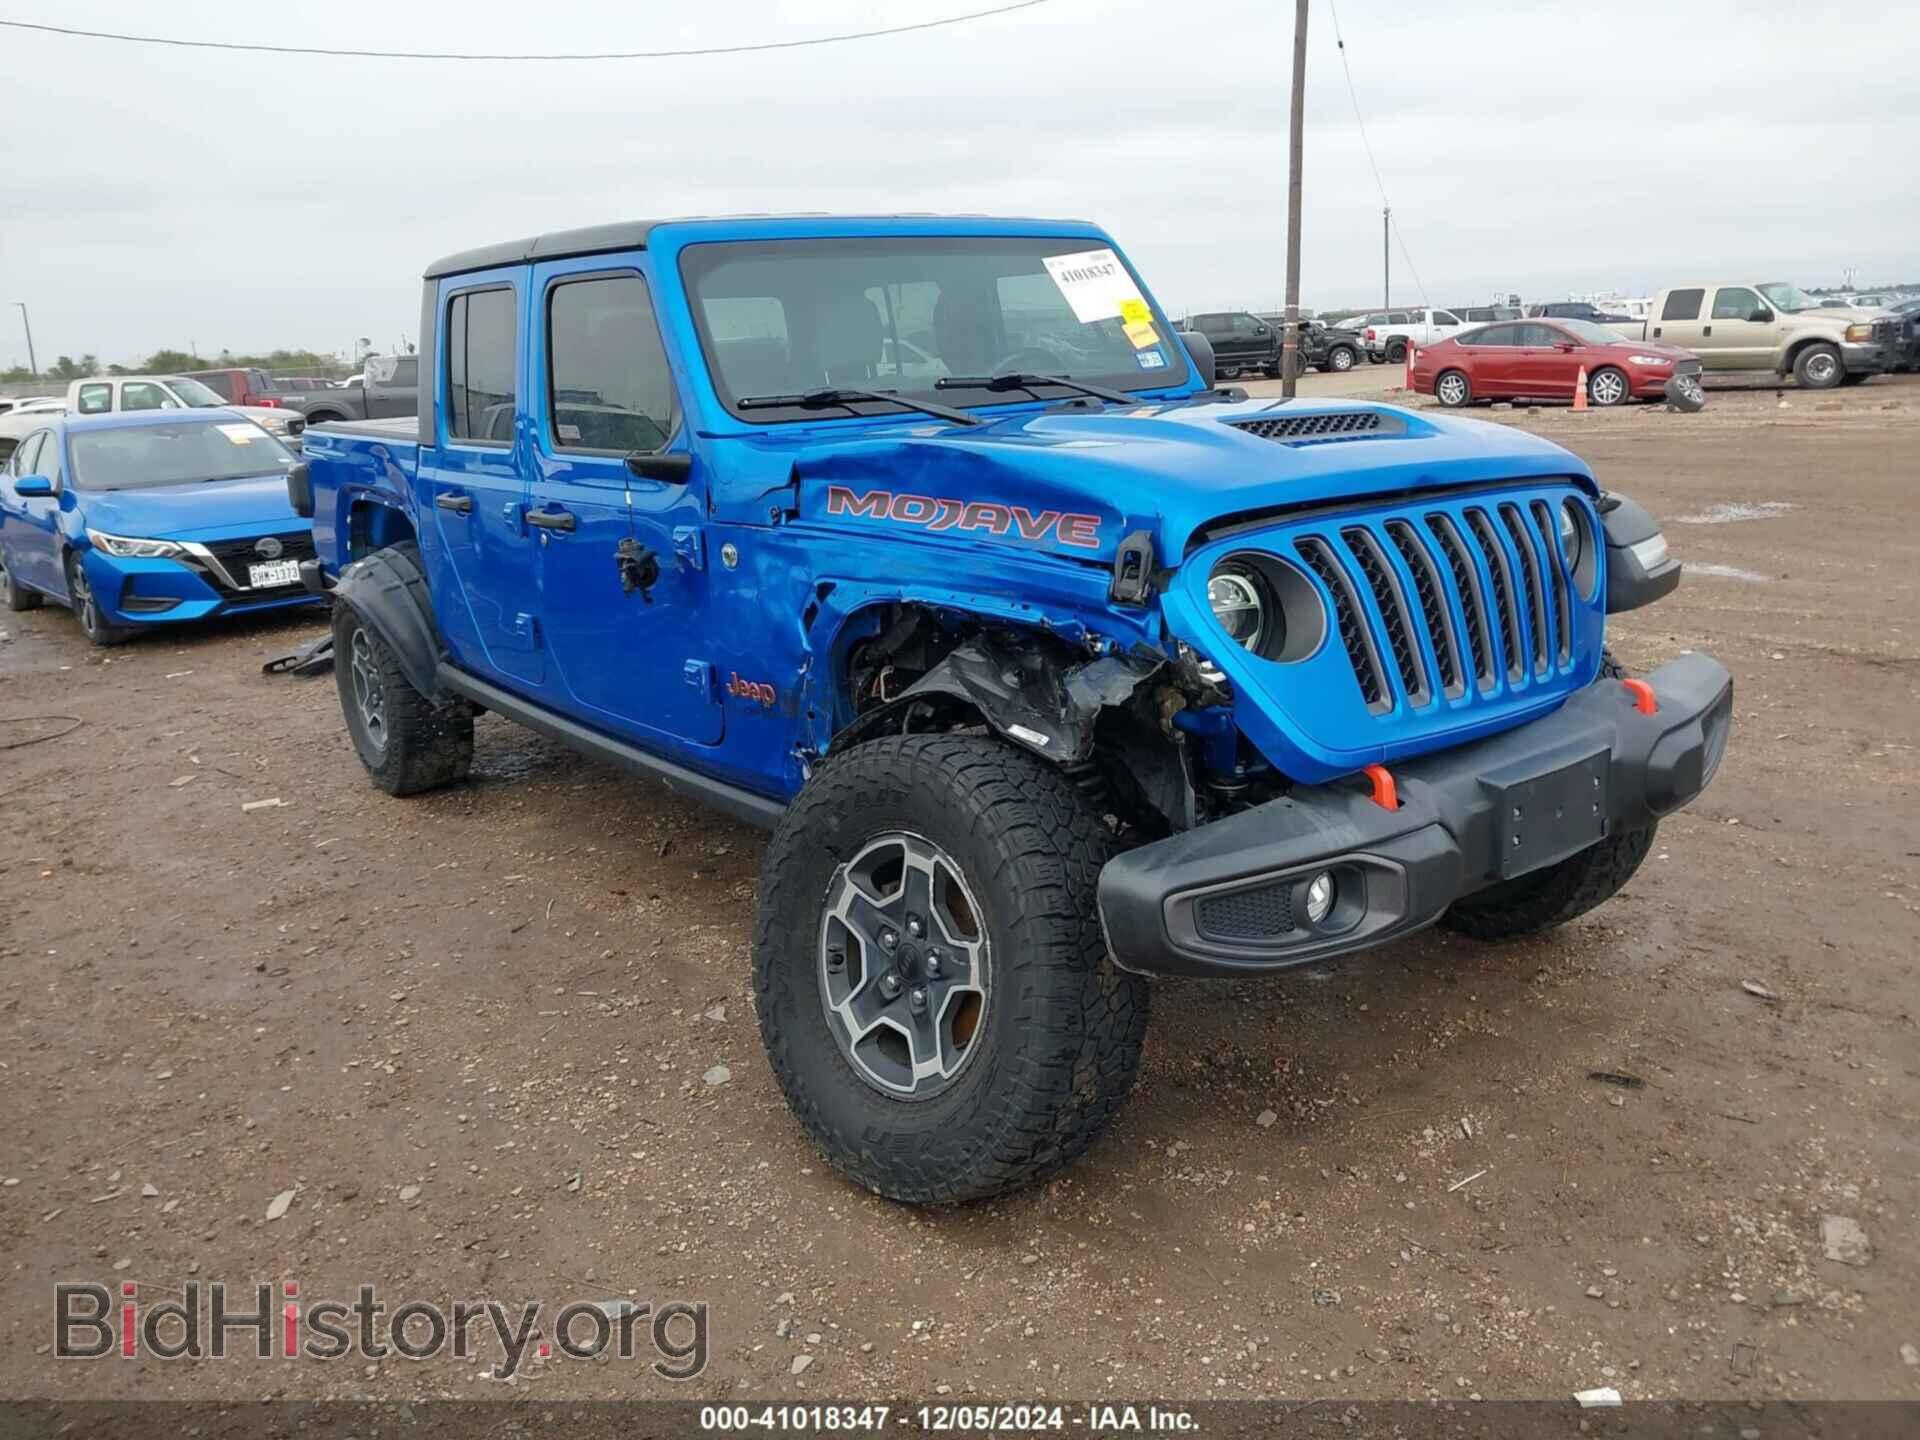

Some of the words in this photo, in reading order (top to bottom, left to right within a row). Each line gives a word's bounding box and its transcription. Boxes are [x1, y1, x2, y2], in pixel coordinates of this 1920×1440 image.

[1060, 263, 1116, 283] 41018347
[826, 484, 1102, 549] MOJAVE
[725, 671, 776, 709] Jeep
